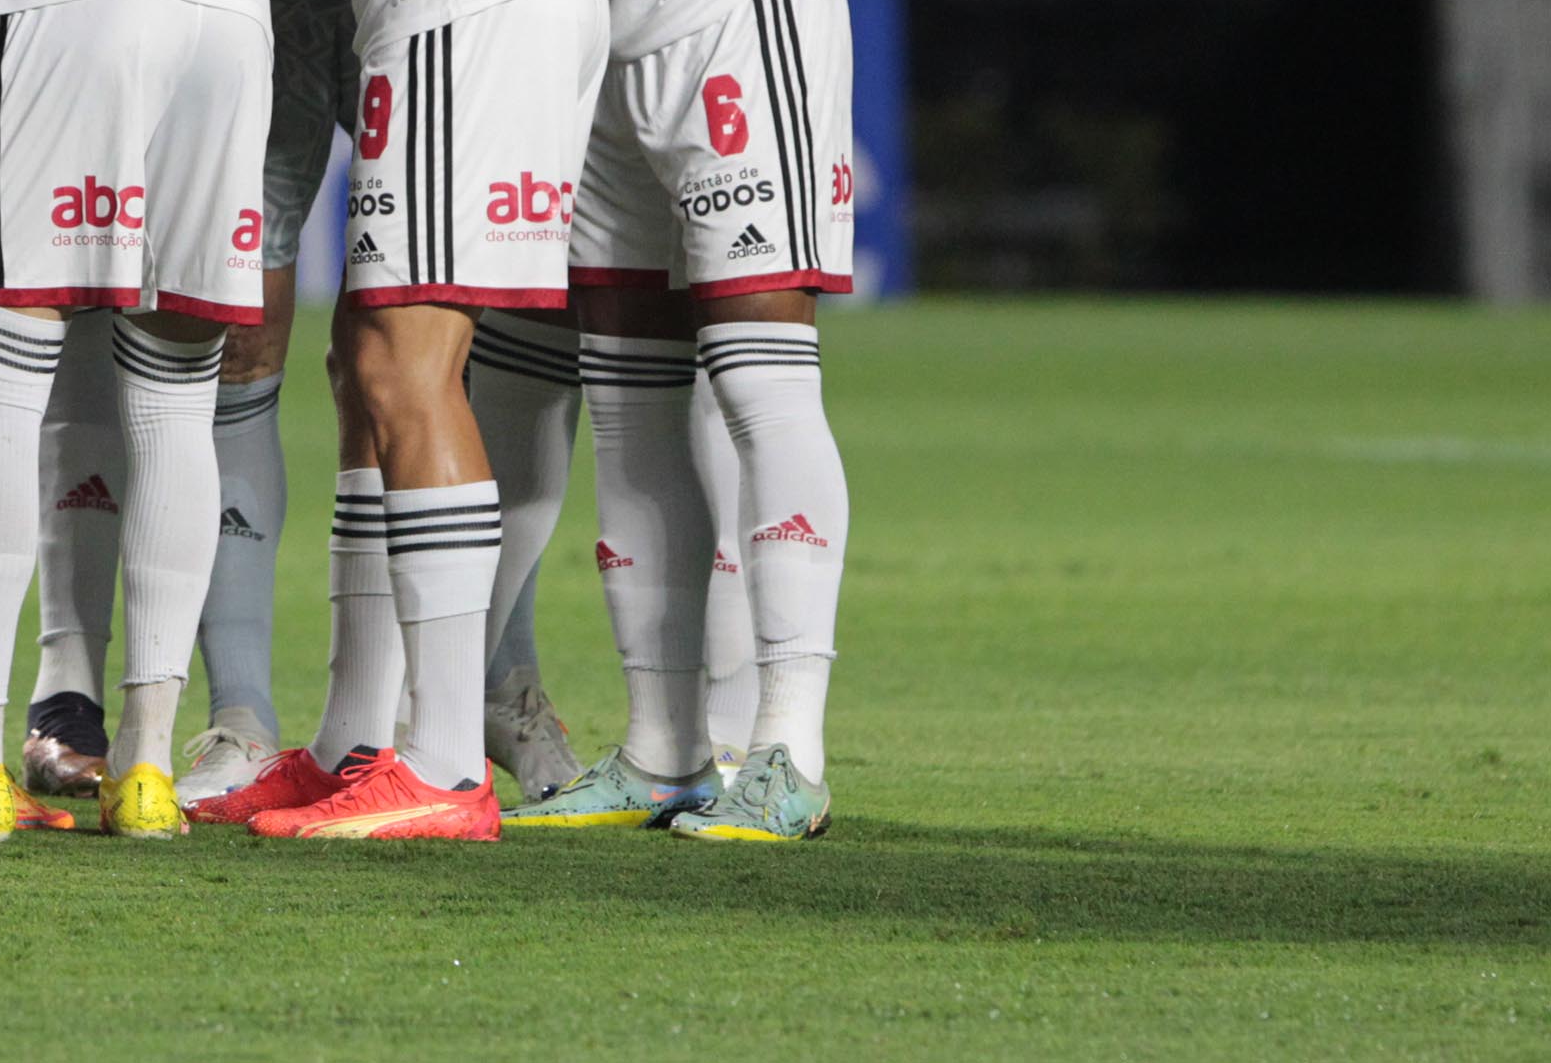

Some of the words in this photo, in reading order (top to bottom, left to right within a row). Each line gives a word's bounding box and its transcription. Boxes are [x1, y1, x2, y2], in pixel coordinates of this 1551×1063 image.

[359, 75, 393, 160] 9
[701, 73, 750, 157] 6
[367, 176, 383, 188] de
[684, 175, 733, 195] Cartão
[739, 166, 759, 180] de
[51, 175, 145, 229] abc
[486, 171, 576, 225] abc
[679, 180, 775, 222] TODOS
[52, 234, 71, 247] da
[486, 230, 504, 243] da
[350, 251, 386, 265] adidas
[727, 242, 776, 260] adidas
[227, 256, 245, 269] da
[751, 528, 828, 548] adidas
